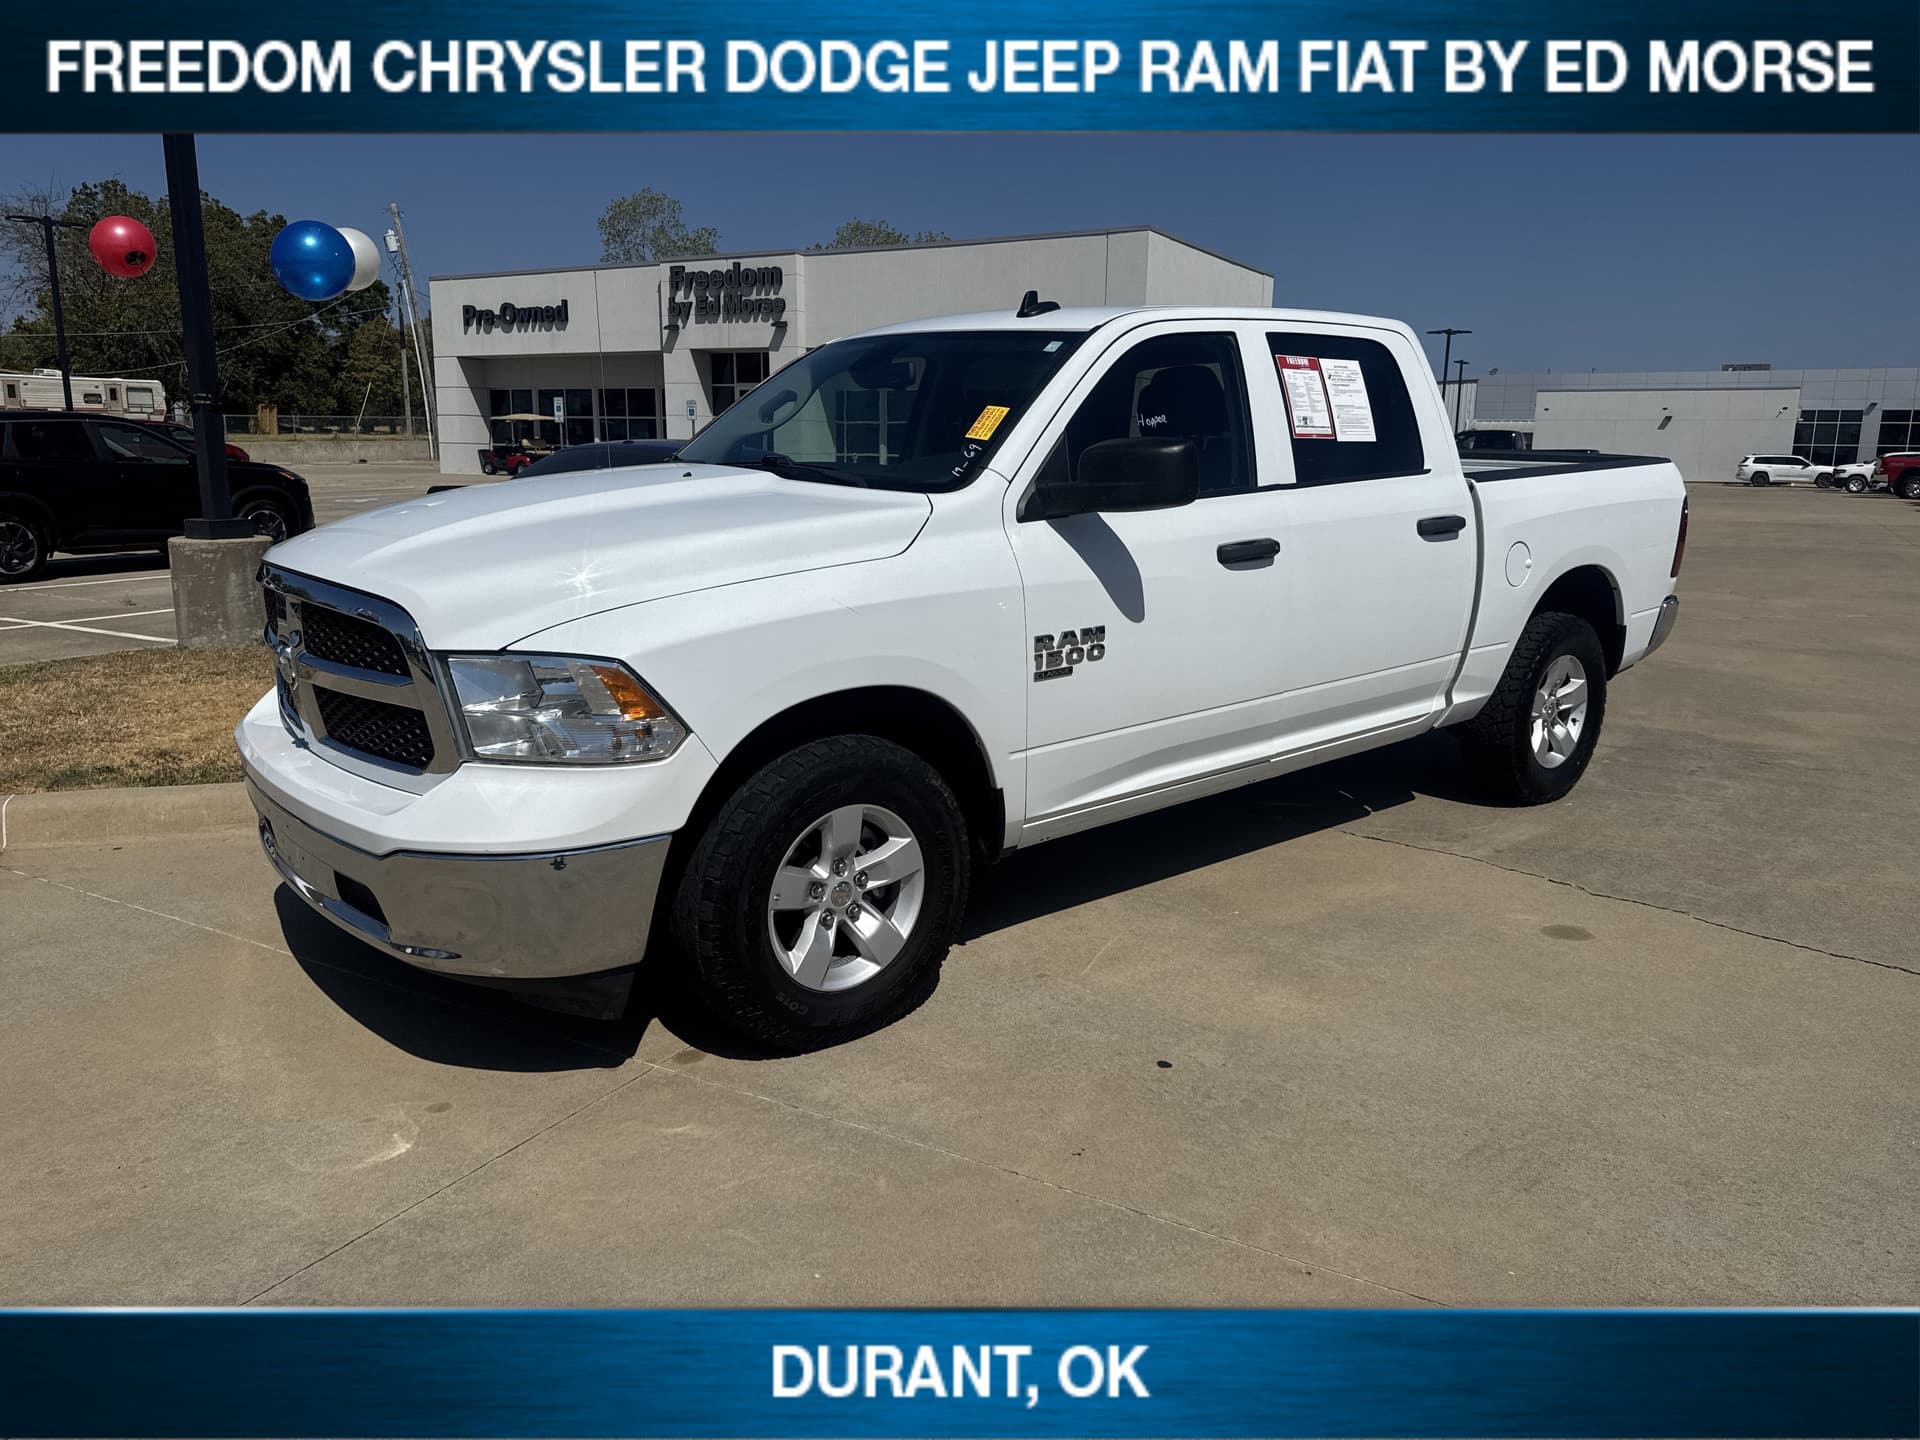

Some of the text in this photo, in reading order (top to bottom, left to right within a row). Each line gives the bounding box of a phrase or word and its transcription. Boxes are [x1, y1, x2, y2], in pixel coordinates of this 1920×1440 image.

[669, 262, 783, 292] Freedom
[462, 299, 568, 328] Pre-Owned
[668, 295, 786, 322] by Ed Morse
[1034, 625, 1105, 653] RAM
[1034, 643, 1105, 671] 1500
